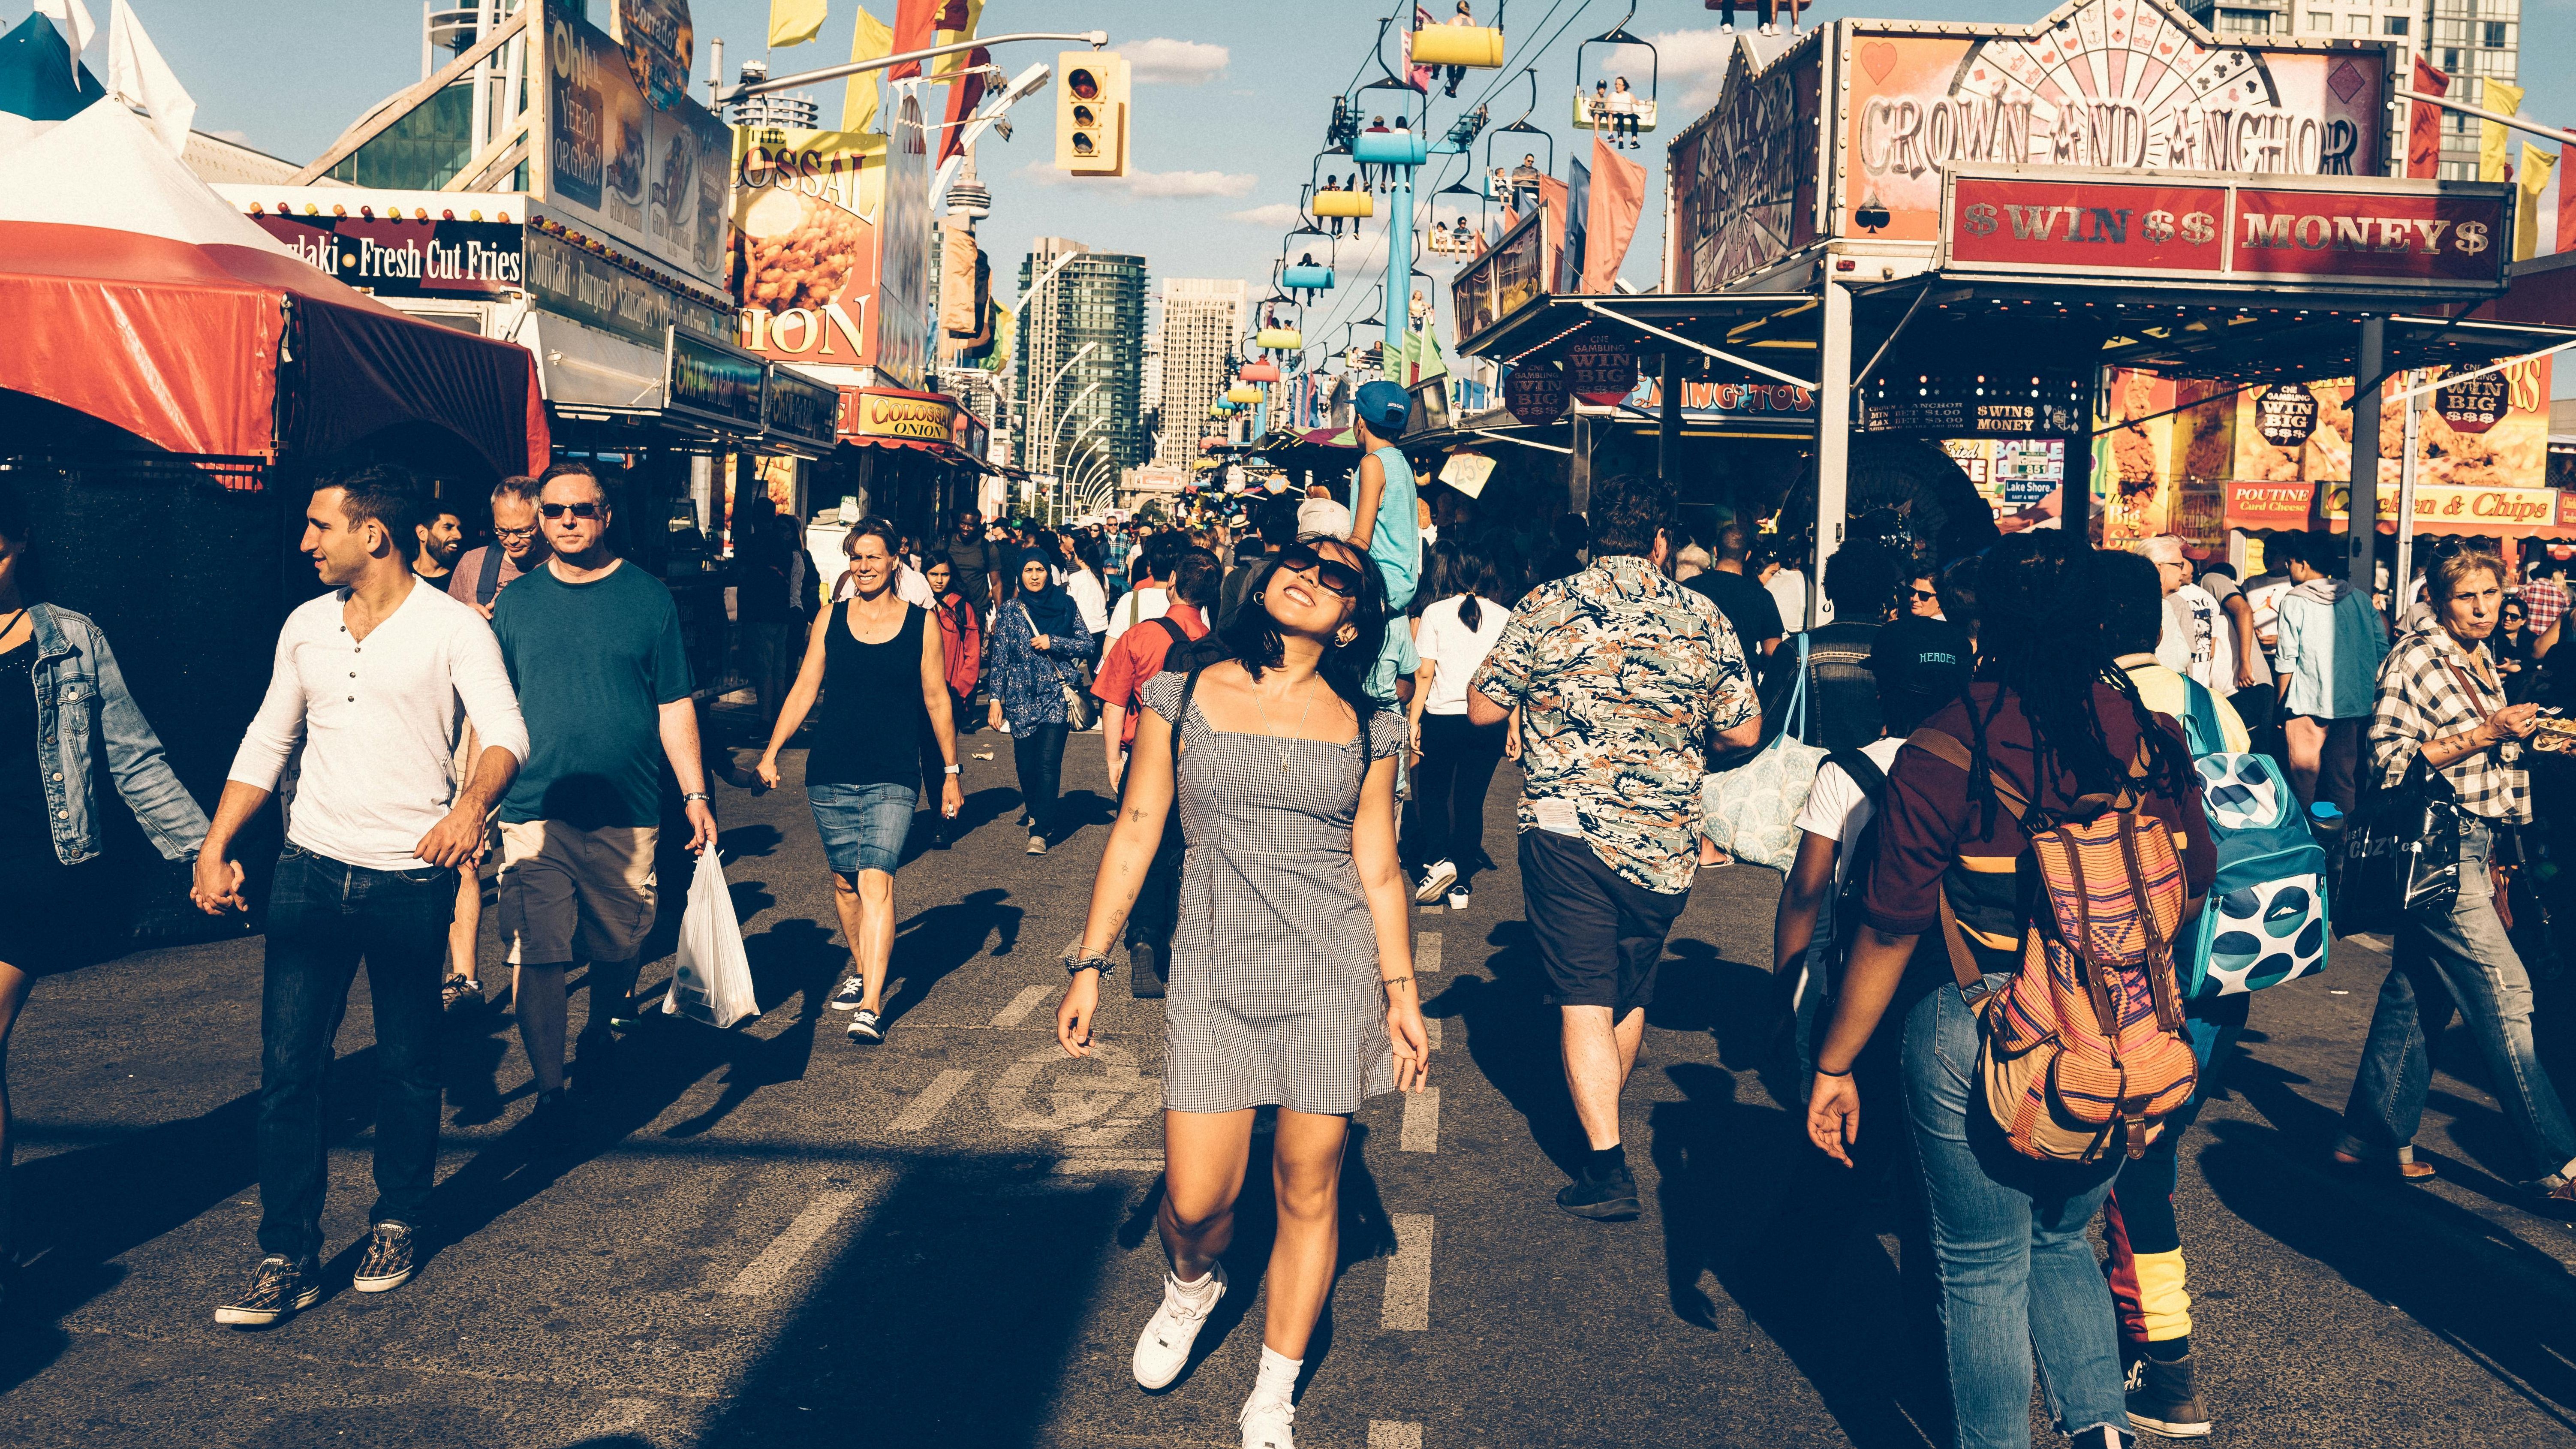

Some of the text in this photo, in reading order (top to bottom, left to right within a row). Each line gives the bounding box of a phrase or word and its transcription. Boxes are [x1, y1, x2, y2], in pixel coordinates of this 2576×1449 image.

[632, 0, 681, 57] Corrado's
[553, 20, 587, 91] Oh!
[561, 86, 596, 143] YEERO
[748, 130, 785, 144] THE
[1860, 80, 2358, 181] CROWN AND ANCHOR
[555, 138, 601, 189] OR GYRO?
[730, 147, 876, 226] OSSAL
[359, 237, 421, 278] Fresh
[427, 239, 462, 280] Cut
[466, 241, 520, 281] Fries
[530, 239, 571, 297] Souvlaki
[578, 260, 611, 313] Burgers
[618, 277, 653, 331] Sausages
[1574, 344, 1625, 352] GAMBLING
[1569, 354, 1632, 368] WIN
[1575, 369, 1626, 383] BIG
[1512, 380, 1563, 392] WIN
[2281, 386, 2298, 394] CNE
[2447, 381, 2504, 396] WIN
[1516, 394, 1559, 405] BIG
[2267, 392, 2311, 401] GAMBLING
[2447, 395, 2497, 411] BIG
[1977, 405, 2034, 418] $WIN$
[2261, 401, 2314, 415] WIN
[1869, 419, 1889, 427] MAX
[1977, 419, 2034, 431] MONEY
[2264, 414, 2308, 428] BIG
[894, 422, 943, 437] ONION
[1944, 442, 1980, 459] Fried
[2026, 465, 2047, 474] 851
[2006, 482, 2050, 492] Lake Shore
[2235, 488, 2310, 502] POUTINE
[2239, 501, 2307, 512] Curd Cheese
[2443, 496, 2465, 515] &
[2472, 492, 2548, 522] Chips
[2107, 505, 2141, 530] Big
[1919, 652, 1956, 664] HEROES
